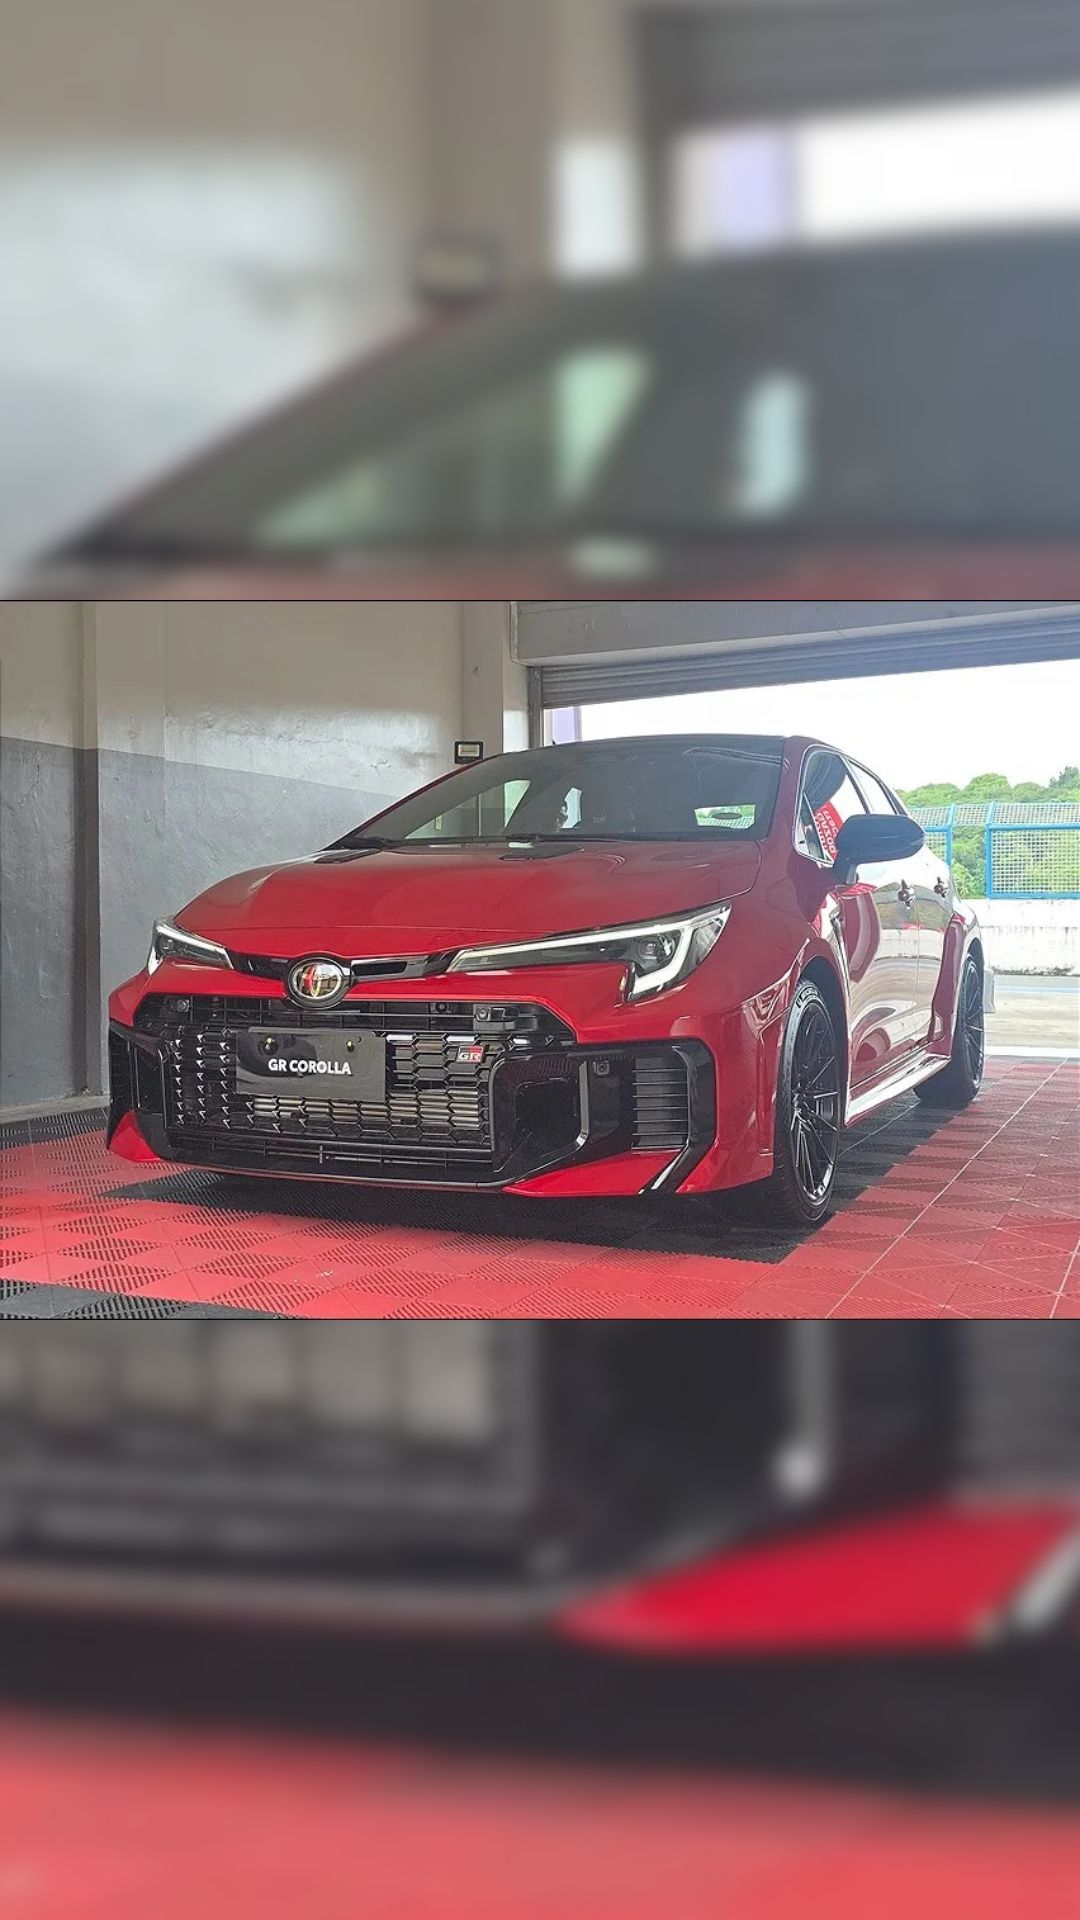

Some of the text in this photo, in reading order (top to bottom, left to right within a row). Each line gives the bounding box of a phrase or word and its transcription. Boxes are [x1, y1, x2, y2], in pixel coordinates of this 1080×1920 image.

[459, 1052, 481, 1060] GR
[268, 1058, 352, 1075] GR COROLLA
